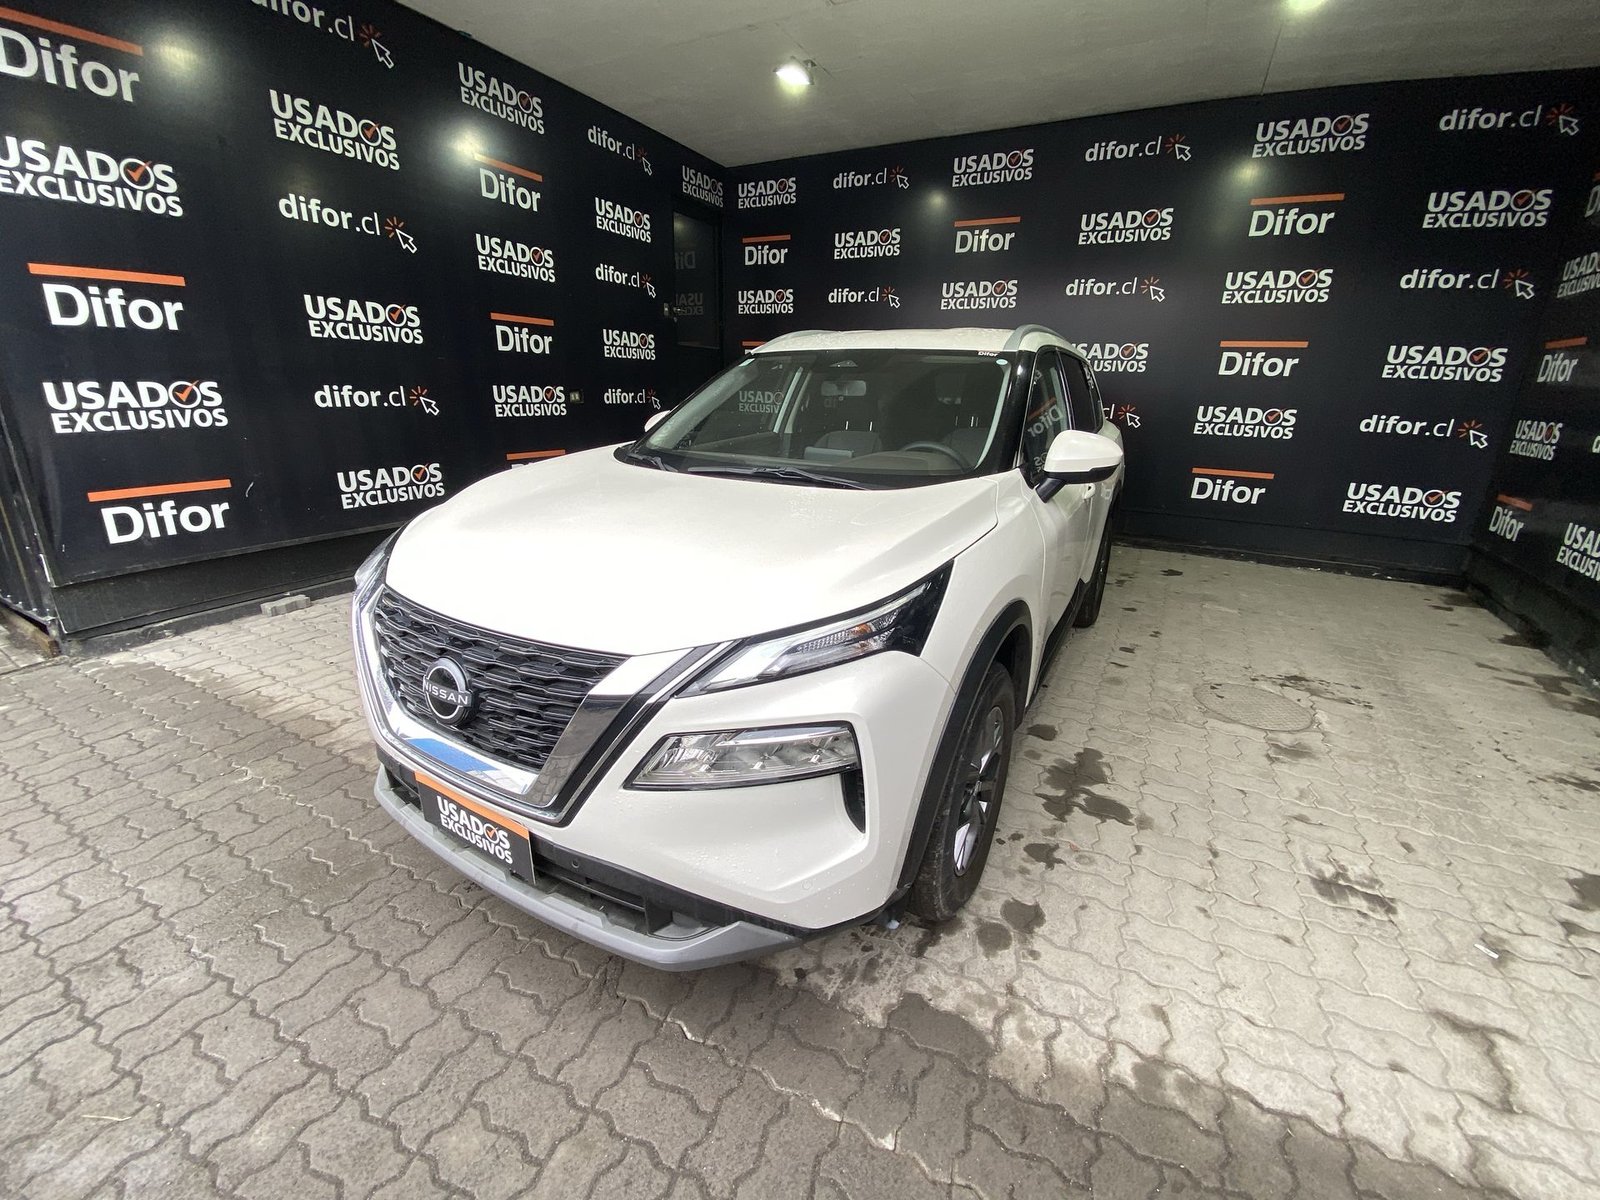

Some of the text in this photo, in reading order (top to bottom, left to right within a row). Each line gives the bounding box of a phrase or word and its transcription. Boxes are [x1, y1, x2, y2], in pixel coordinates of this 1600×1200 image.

[0, 27, 140, 103] Difor
[458, 62, 543, 118] USADOS
[269, 89, 397, 151] USADOS
[460, 86, 545, 135] EXCLUSIVOS
[1439, 105, 1542, 131] difor.cl
[1256, 113, 1370, 141] USADOS
[274, 118, 400, 171] EXCLUSIVOS
[587, 125, 635, 160] difor.cl
[1085, 136, 1162, 162] difor.cl
[1251, 134, 1367, 159] EXCLUSIVOS
[0, 136, 178, 193] USADOS
[953, 149, 1034, 174] USADOS
[479, 168, 541, 212] Difor
[682, 165, 723, 197] USADOS
[738, 177, 796, 198] USADOS
[833, 167, 887, 189] difor.cl
[952, 167, 1033, 188] EXCLUSIVOS
[0, 170, 183, 217] EXCLUSIVOS
[682, 181, 724, 208] EXCLUSIVOS
[738, 193, 796, 209] EXCLUSIVOS
[1427, 189, 1553, 213] USADOS
[279, 194, 381, 236] difor.cl
[595, 197, 650, 230] USADOS
[1080, 207, 1174, 231] USADOS
[1248, 207, 1335, 237] Difor
[1422, 211, 1549, 229] EXCLUSIVOS
[596, 216, 651, 243] EXCLUSIVOS
[834, 228, 900, 248] USADOS
[955, 229, 1015, 254] Difor
[1078, 226, 1171, 245] EXCLUSIVOS
[475, 233, 554, 268] USADOS
[744, 245, 788, 266] Difor
[834, 244, 900, 260] EXCLUSIVOS
[478, 255, 556, 283] EXCLUSIVOS
[595, 263, 640, 288] difor.cl
[1225, 268, 1334, 290] USADOS
[1400, 268, 1500, 289] difor.cl
[1563, 252, 1600, 281] USAD
[738, 289, 794, 304] USADOS
[828, 287, 879, 303] difor.cl
[942, 279, 1018, 298] USADOS
[1065, 277, 1138, 296] difor.cl
[1221, 288, 1329, 304] EXCLUSIVOS
[1557, 272, 1600, 298] EXCLUSIV
[42, 283, 184, 331] Difor
[303, 294, 420, 327] USADOS
[738, 303, 794, 315] EXCLUSIVOS
[940, 296, 1017, 310] EXCLUSIVOS
[309, 320, 424, 344] EXCLUSIVOS
[495, 324, 553, 354] Difor
[602, 328, 655, 349] USADOS
[604, 346, 656, 361] EXCLUSIVOS
[1072, 343, 1149, 360] SADOS
[1218, 351, 1299, 377] Difor
[1386, 345, 1508, 367] USADOS
[1092, 360, 1147, 373] USIVOS
[1381, 365, 1503, 383] EXCLUSIVOS
[1536, 352, 1579, 383] Difor
[42, 381, 222, 411] USADOS
[314, 385, 406, 408] difor.cl
[492, 385, 565, 403] USADOS
[604, 388, 646, 404] difor.cl
[739, 391, 784, 405] USADO
[50, 408, 228, 434] EXCLUSIVOS
[495, 402, 567, 417] EXCLUSIVOS
[739, 404, 780, 413] EXCLUSIV
[1196, 405, 1297, 426] USADOS
[1193, 423, 1294, 440] EXCLUSIVOS
[1359, 414, 1455, 437] difor.cl
[1515, 420, 1563, 444] USADOS
[1509, 440, 1557, 461] EXCLUSIVOS
[337, 463, 442, 493] USADOS
[341, 482, 445, 510] EXCLUSIVOS
[1190, 477, 1266, 505] Difor
[1347, 482, 1462, 509] USADOS
[101, 501, 229, 545] Difor
[1342, 500, 1457, 523] EXCLUSIVOS
[1488, 506, 1525, 542] Difor
[424, 681, 469, 705] NISSAN
[437, 795, 511, 850] USADOS
[441, 813, 513, 865] EXCLUSIVOS
